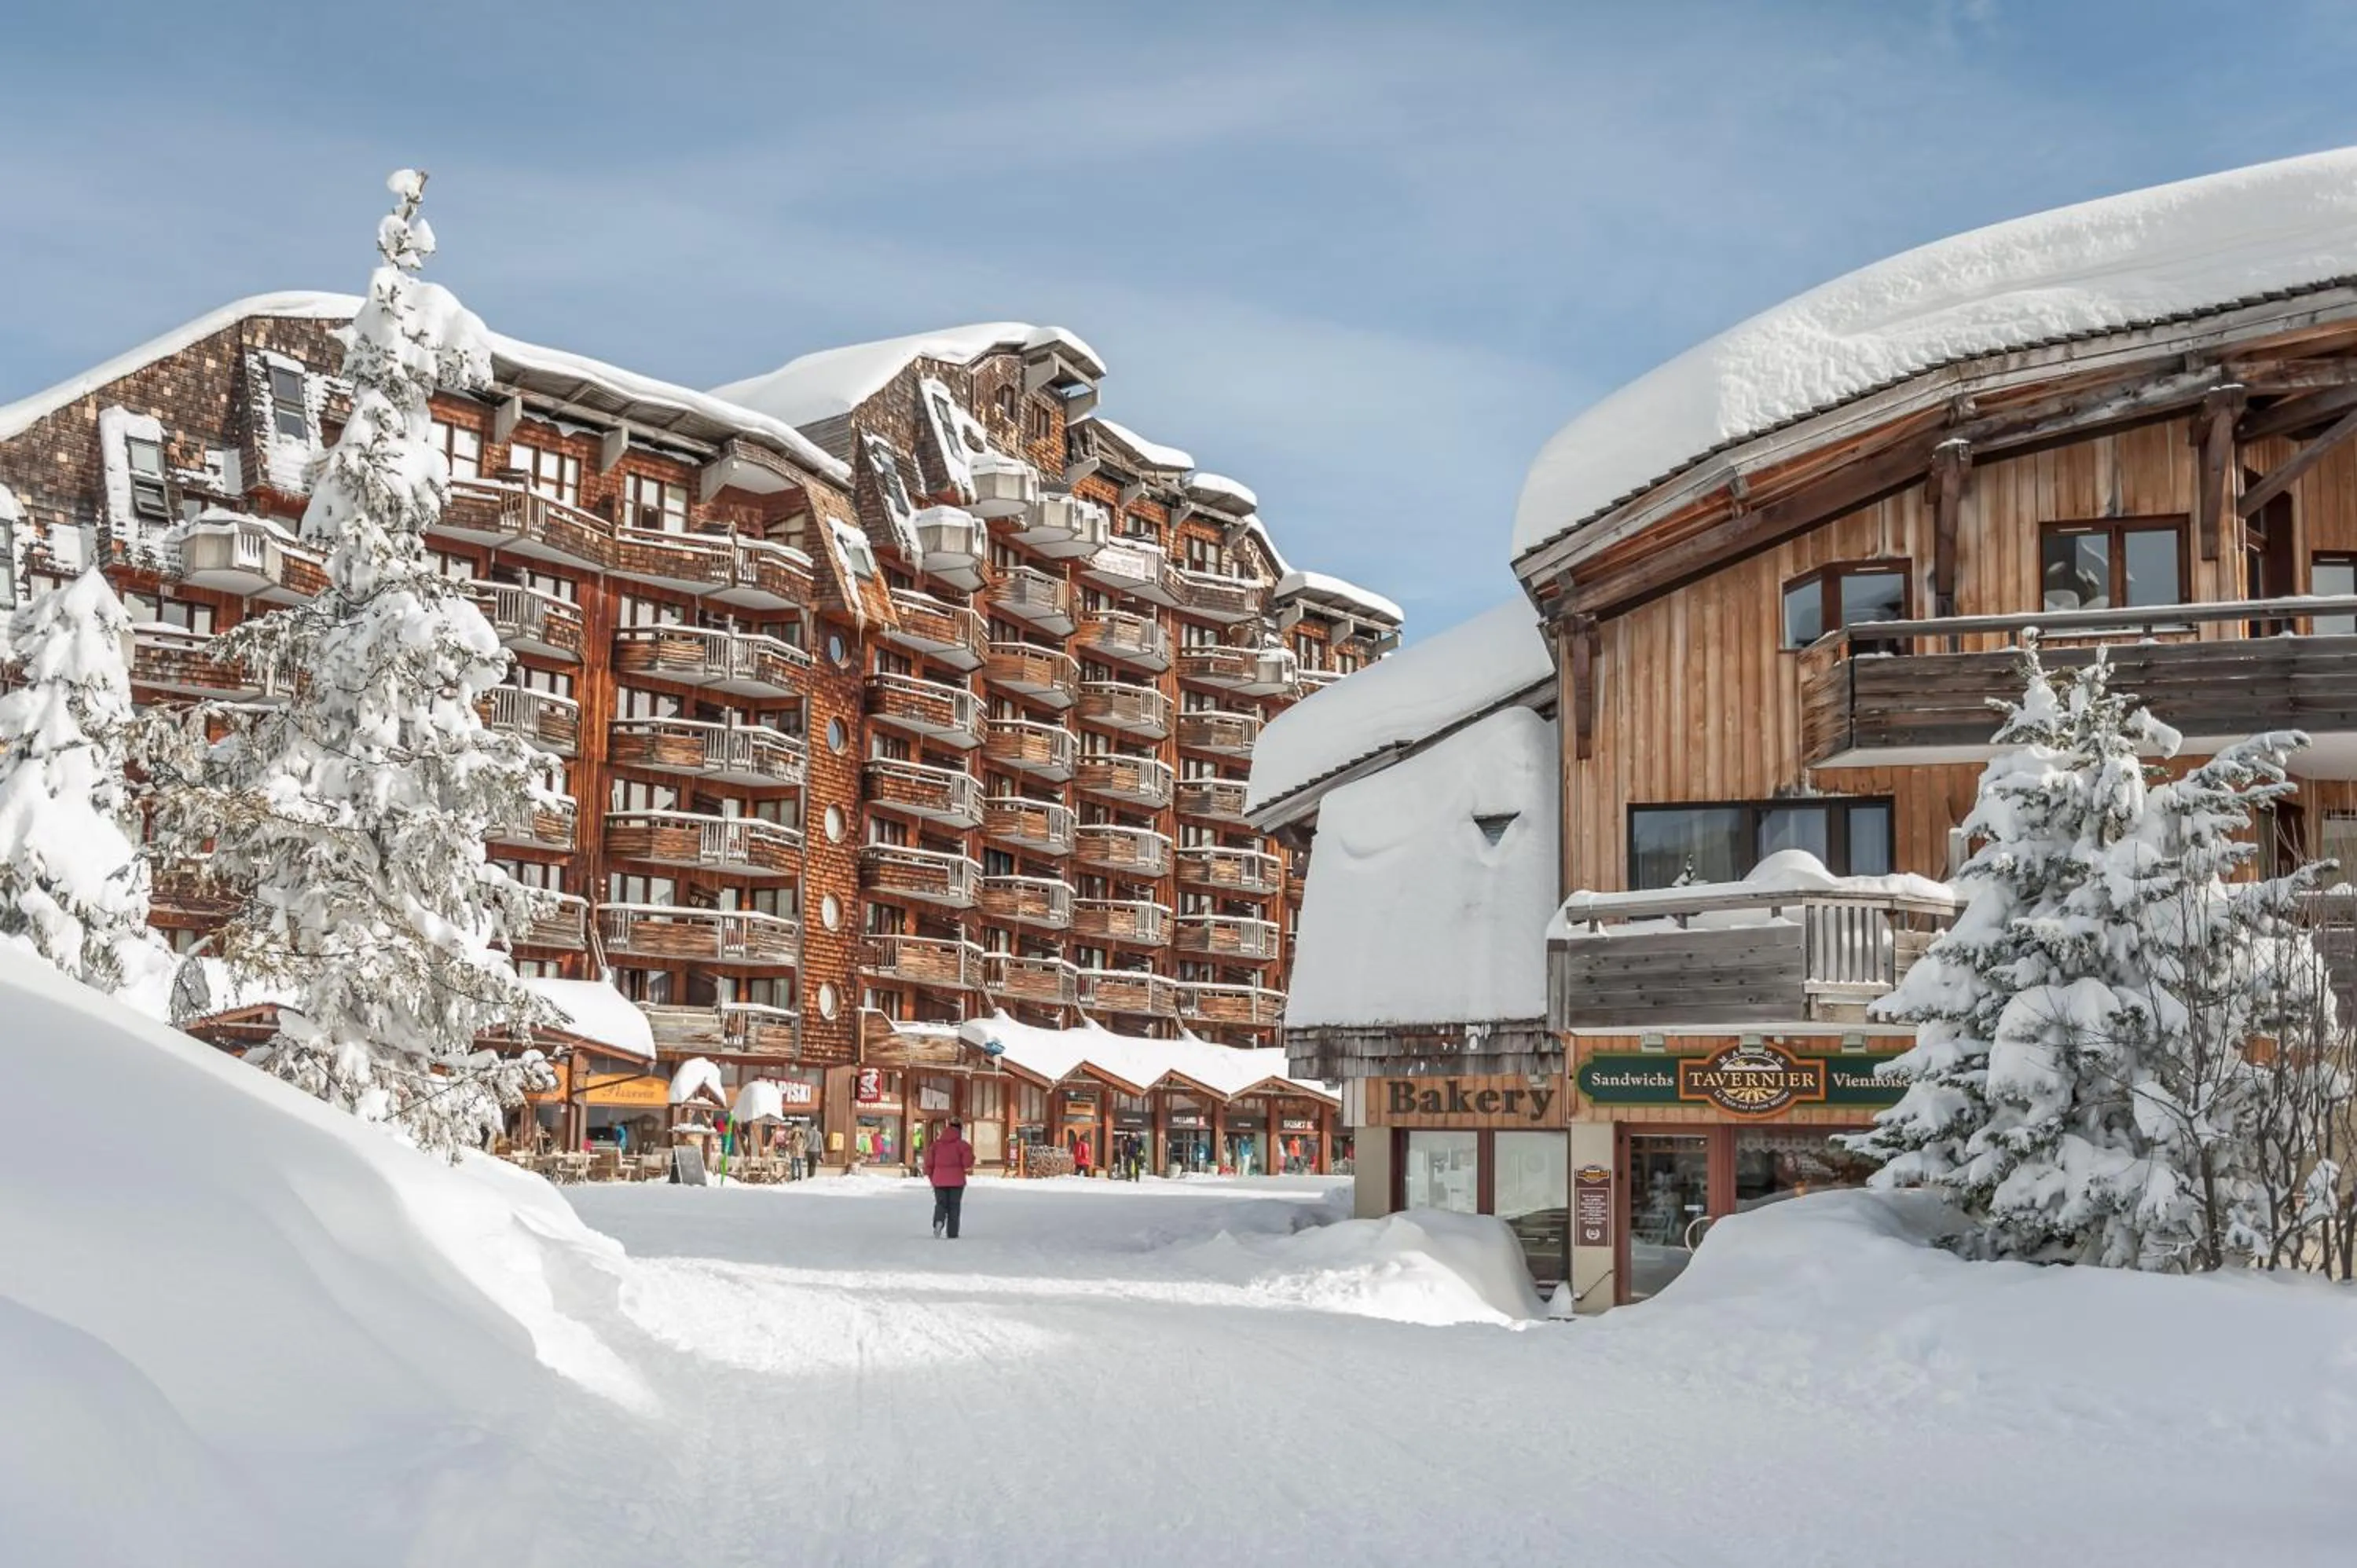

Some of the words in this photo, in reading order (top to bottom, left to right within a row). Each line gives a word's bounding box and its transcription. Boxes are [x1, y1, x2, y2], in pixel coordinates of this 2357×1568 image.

[1717, 1050, 1785, 1064] MAON
[1591, 1072, 1674, 1086] Sandwichs
[1689, 1072, 1815, 1087] TAVERNIER
[1387, 1080, 1555, 1121] Bakery
